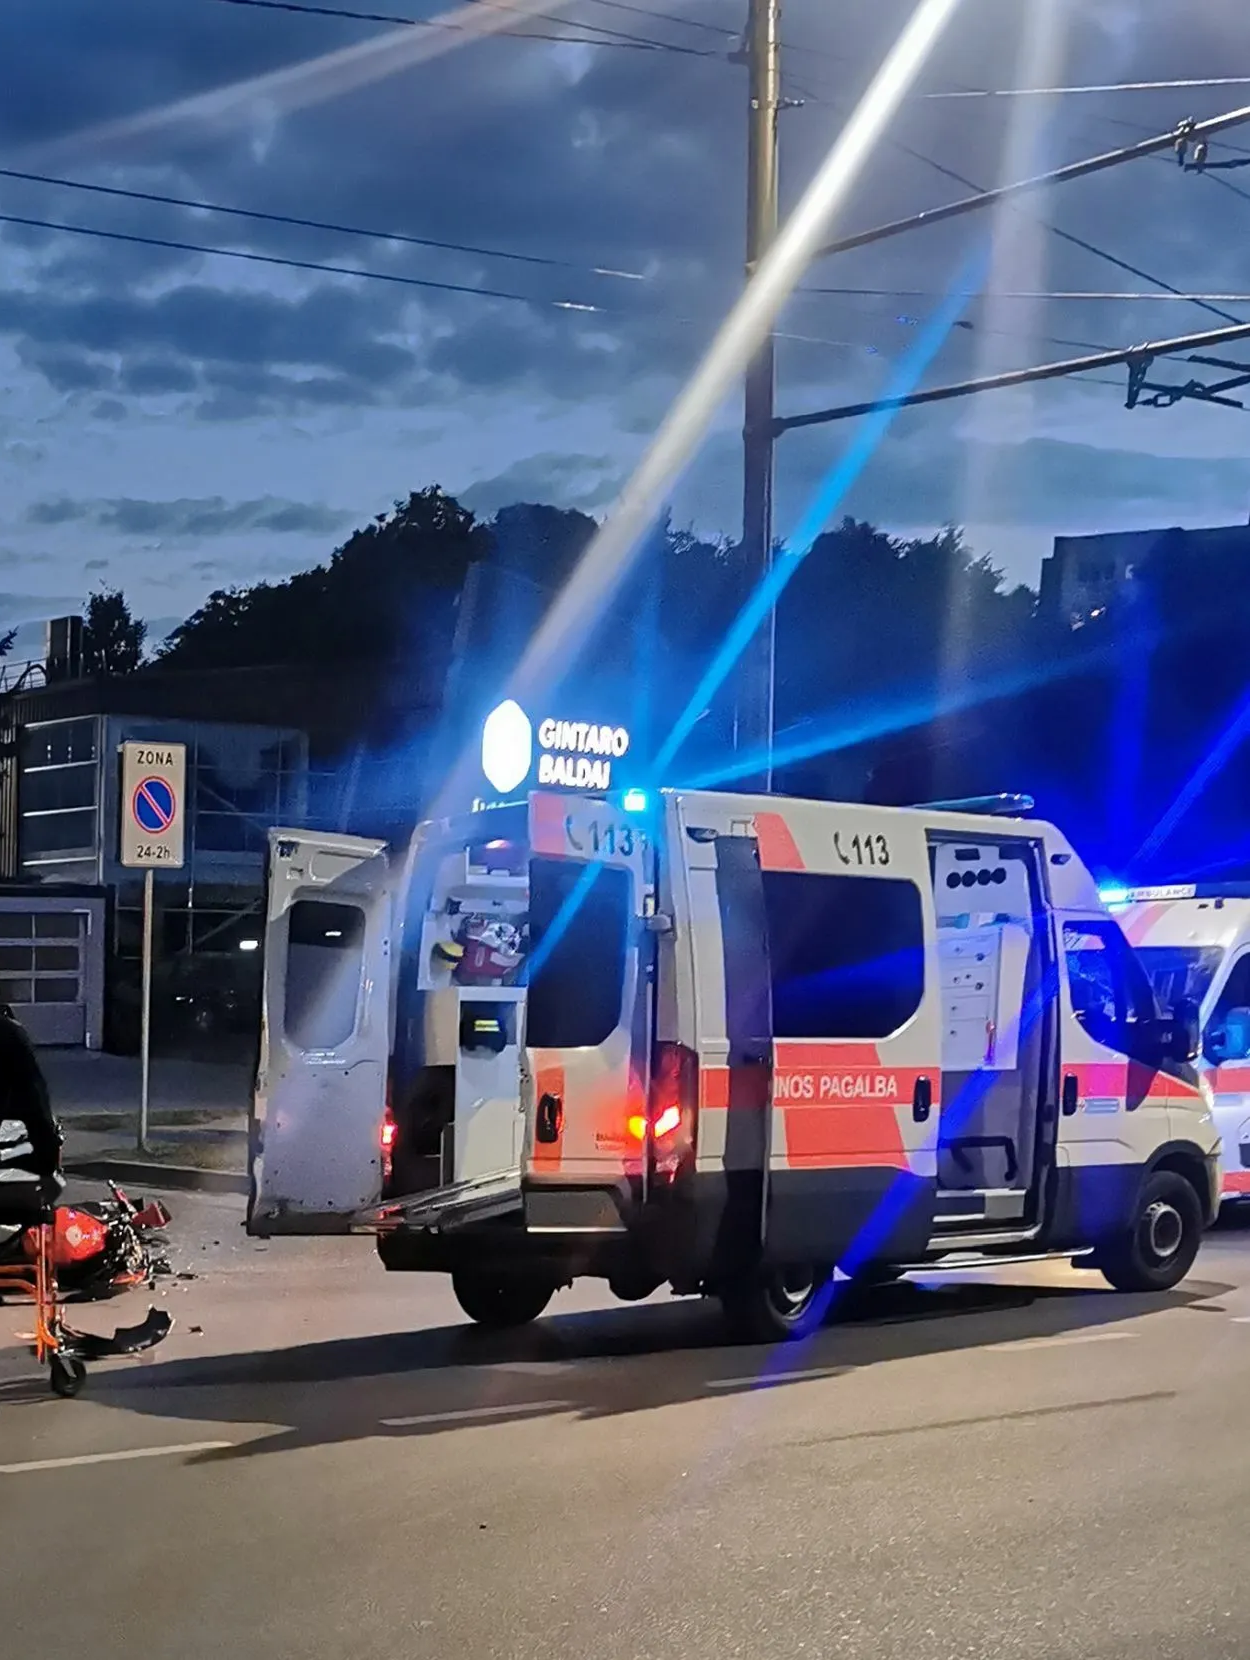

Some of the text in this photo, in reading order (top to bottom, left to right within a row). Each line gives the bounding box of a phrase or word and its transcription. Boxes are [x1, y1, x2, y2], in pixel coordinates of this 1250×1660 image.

[538, 717, 629, 757] GINTARO
[137, 750, 173, 766] ZONA
[538, 753, 610, 789] BALDAI
[137, 845, 170, 859] 24-2h
[589, 820, 634, 856] 113
[852, 834, 889, 865] 113
[819, 1074, 898, 1098] PAGALBA
